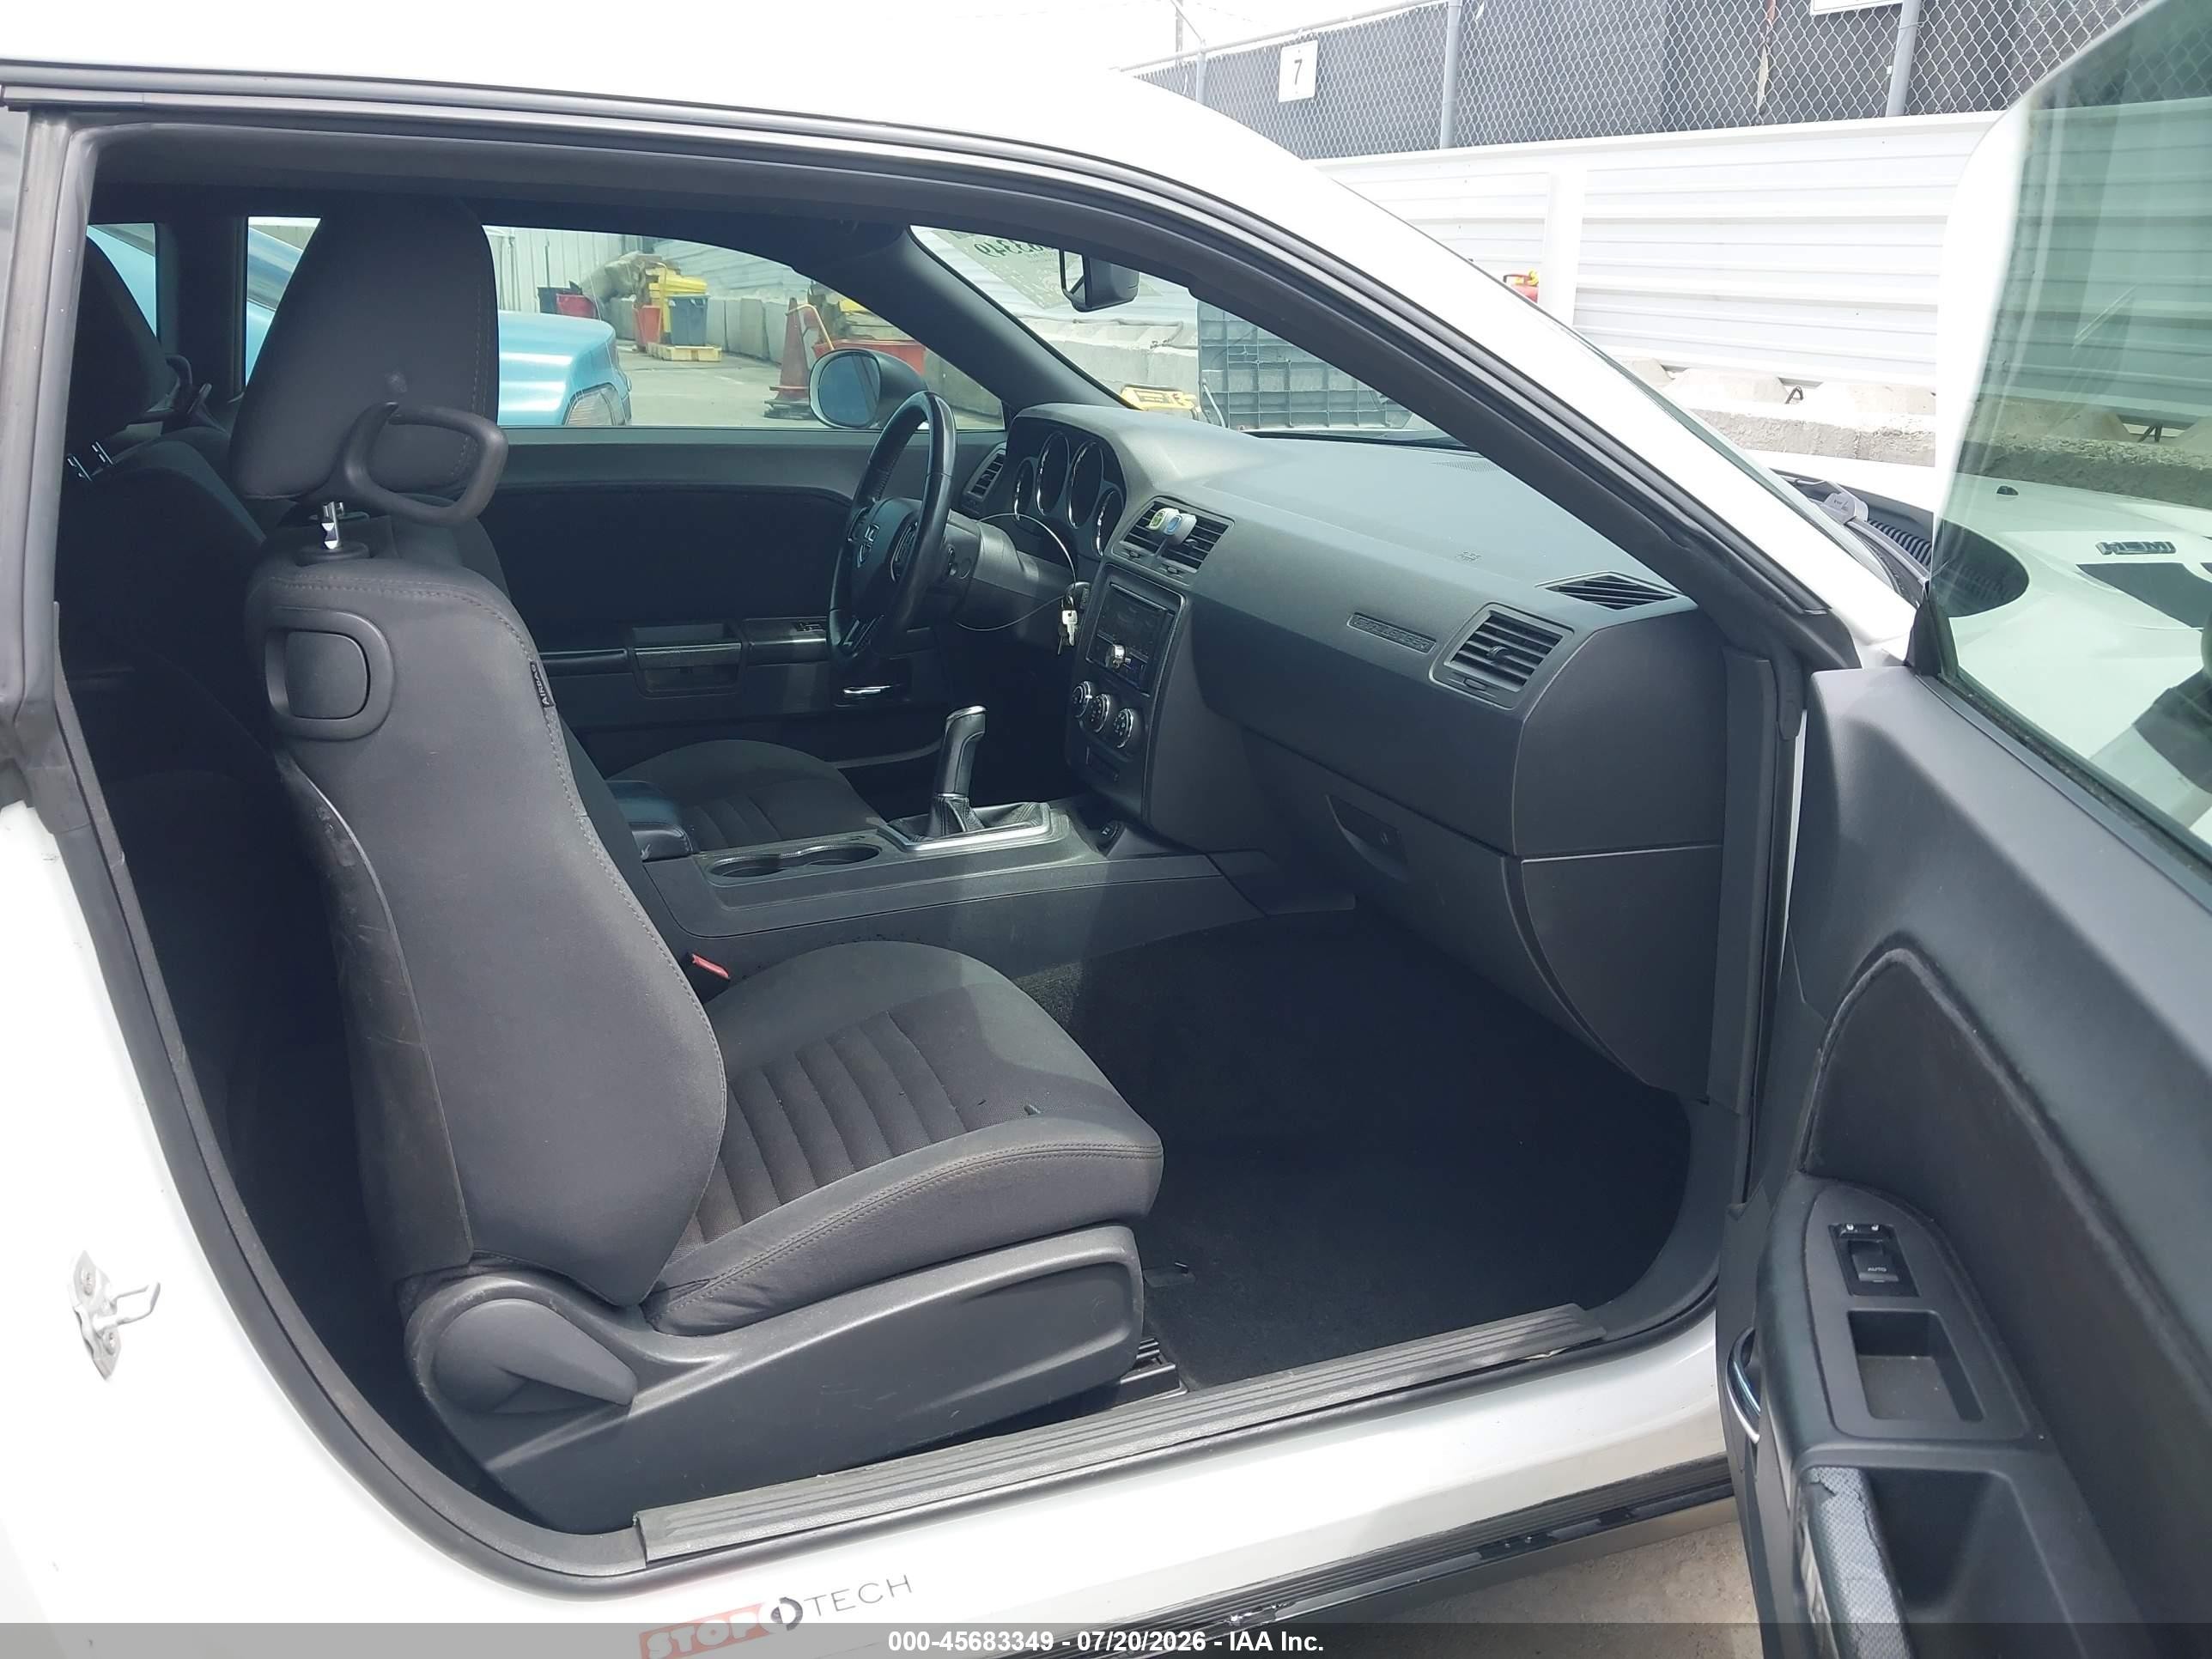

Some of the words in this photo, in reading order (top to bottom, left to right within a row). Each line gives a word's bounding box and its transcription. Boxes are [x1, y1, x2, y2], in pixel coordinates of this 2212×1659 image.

[1294, 58, 1303, 85] 7
[2095, 541, 2177, 556] HEMI
[532, 664, 550, 705] AIRBAG
[804, 1575, 912, 1617] TECH
